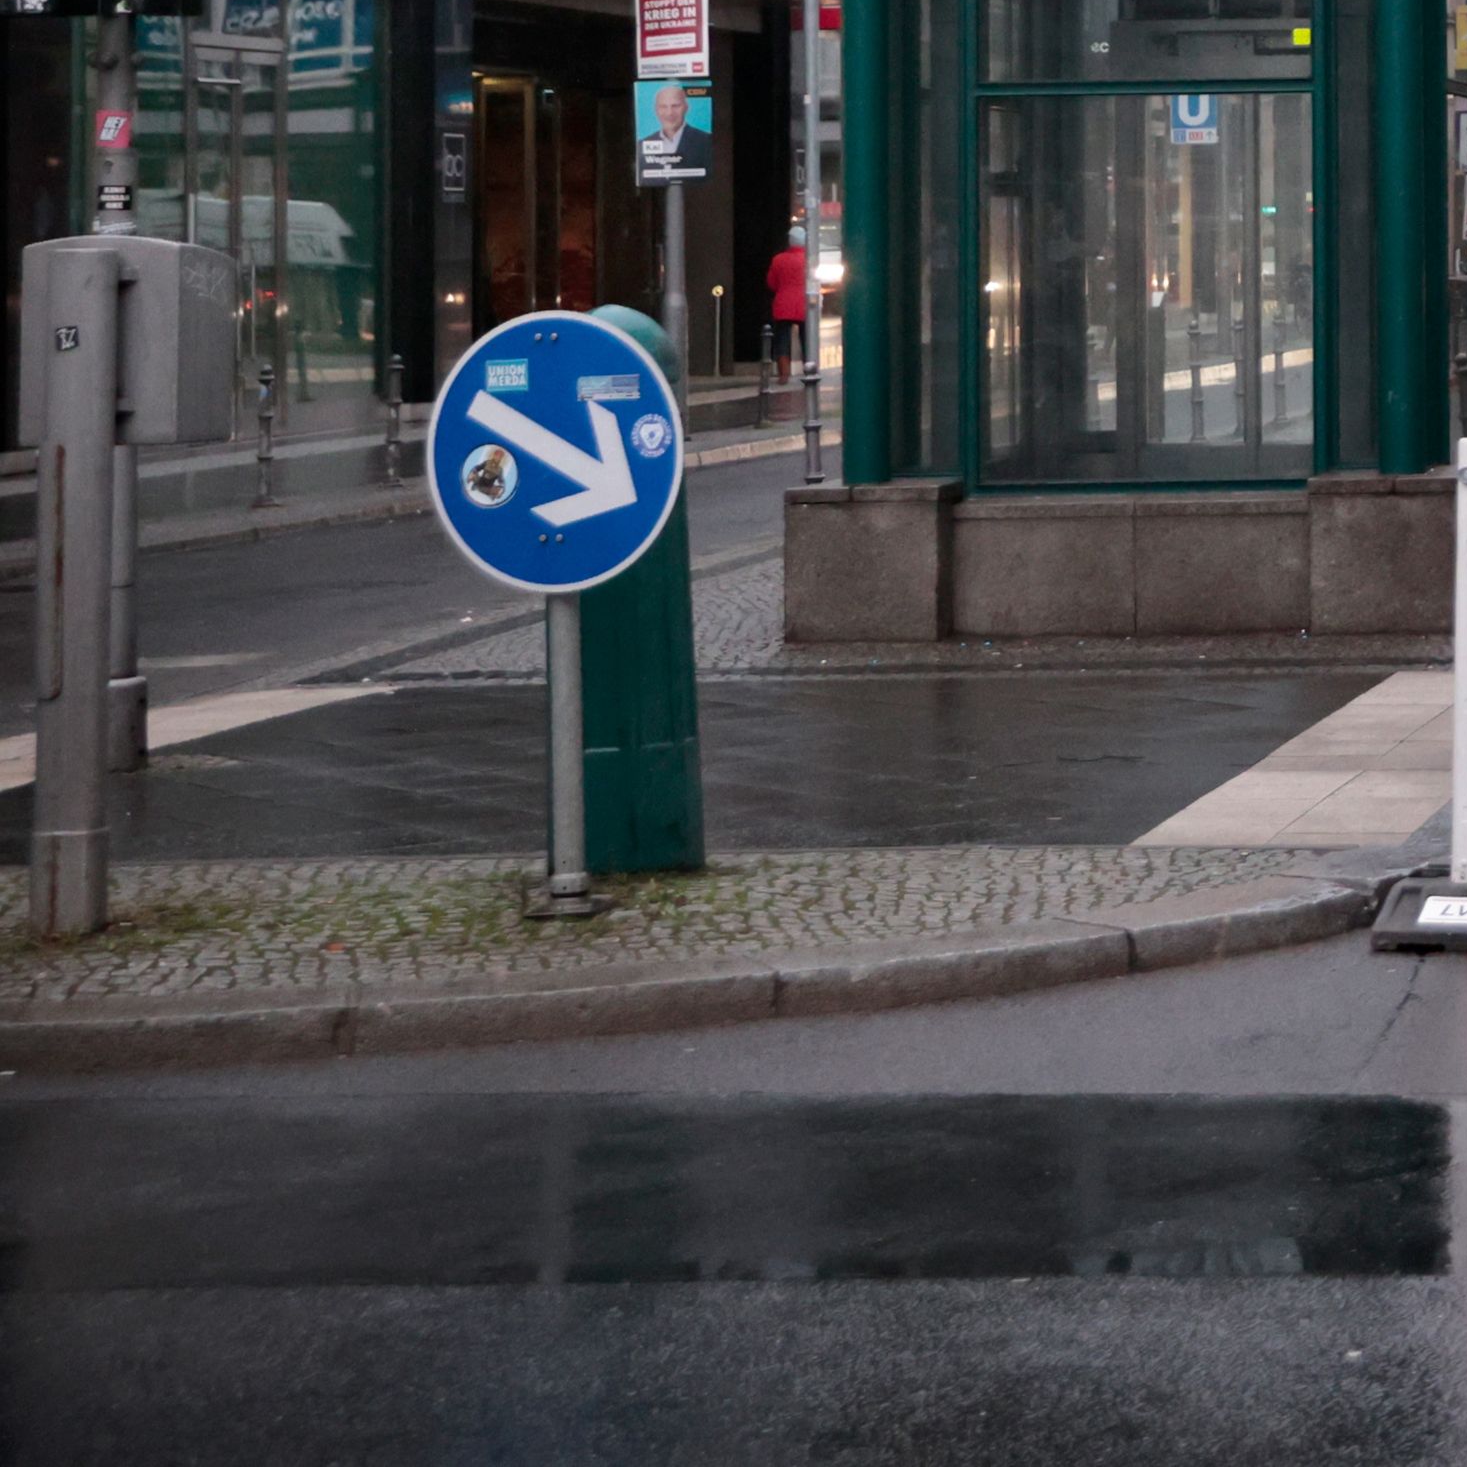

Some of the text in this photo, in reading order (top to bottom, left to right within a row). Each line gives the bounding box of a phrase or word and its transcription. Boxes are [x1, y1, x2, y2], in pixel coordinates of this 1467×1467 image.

[643, 5, 697, 21] KRIEG IN
[1178, 94, 1211, 127] U
[487, 364, 526, 376] UNION
[488, 375, 527, 388] MERDA
